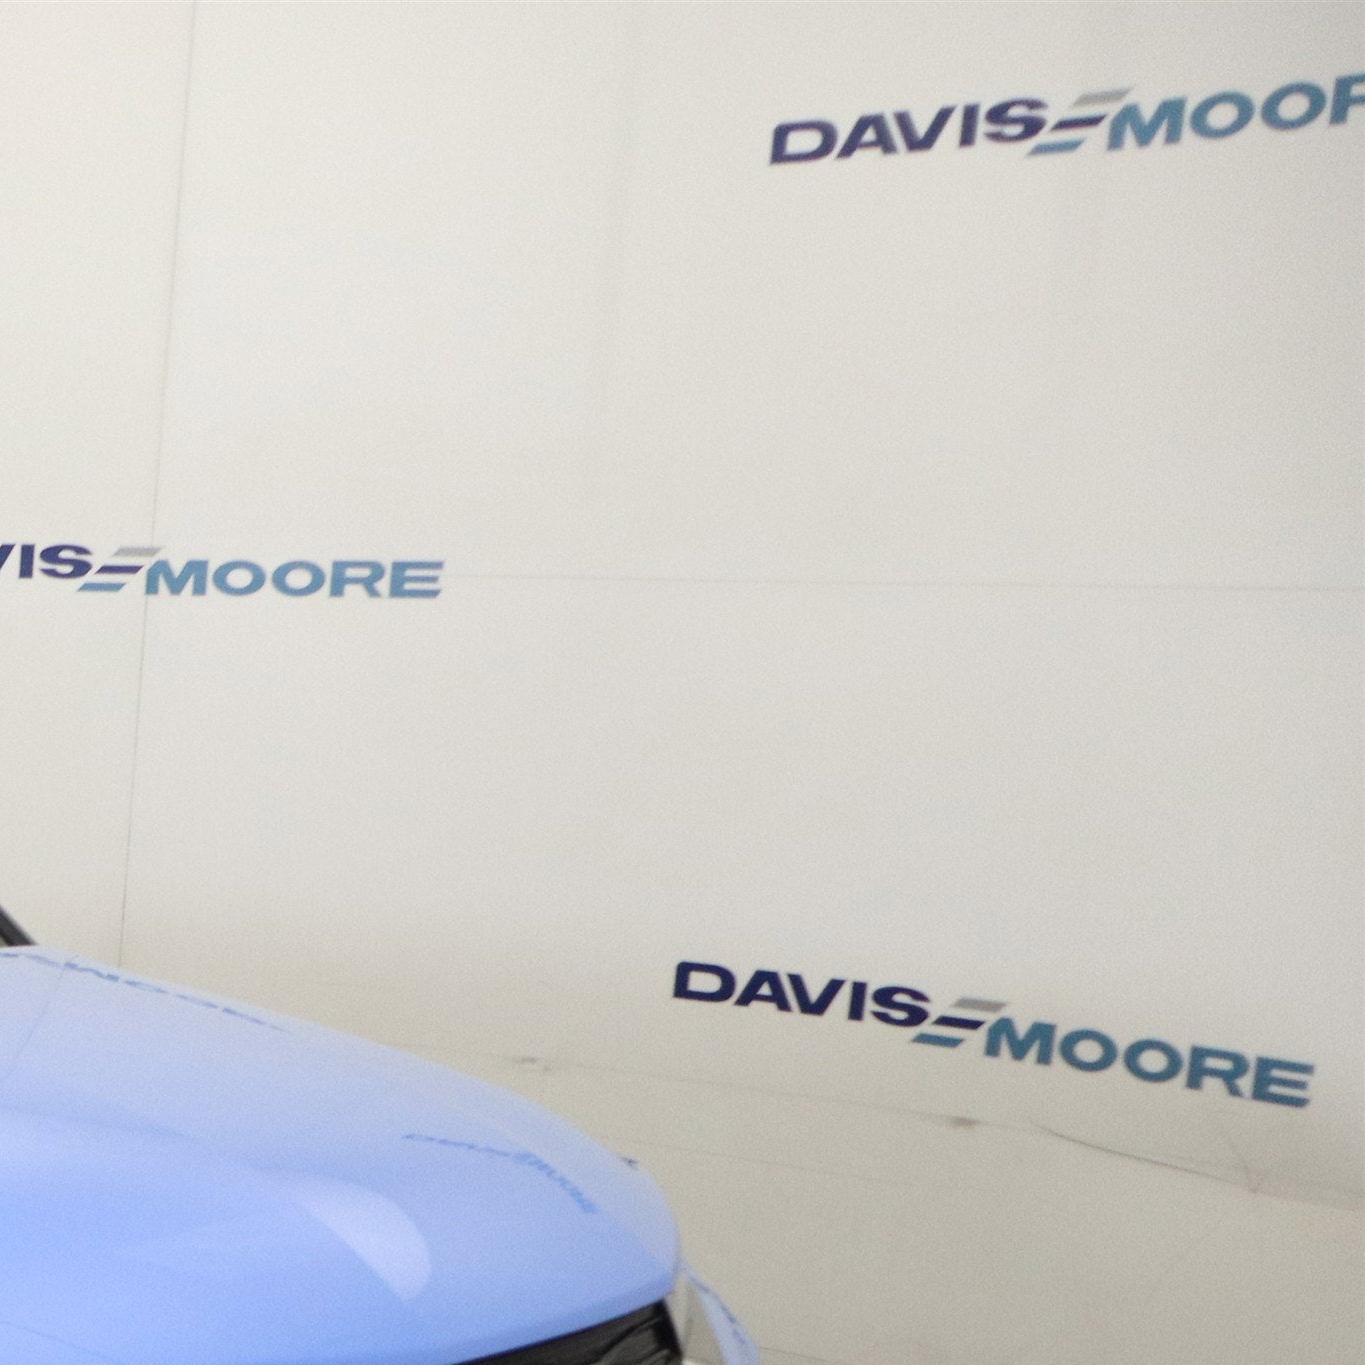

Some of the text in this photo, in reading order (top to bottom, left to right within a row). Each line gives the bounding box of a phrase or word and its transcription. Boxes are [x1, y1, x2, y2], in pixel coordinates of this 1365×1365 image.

[769, 97, 1047, 165] DAVIS
[144, 558, 446, 599] MOORE
[672, 960, 1315, 1109] DAVIS MOORE
